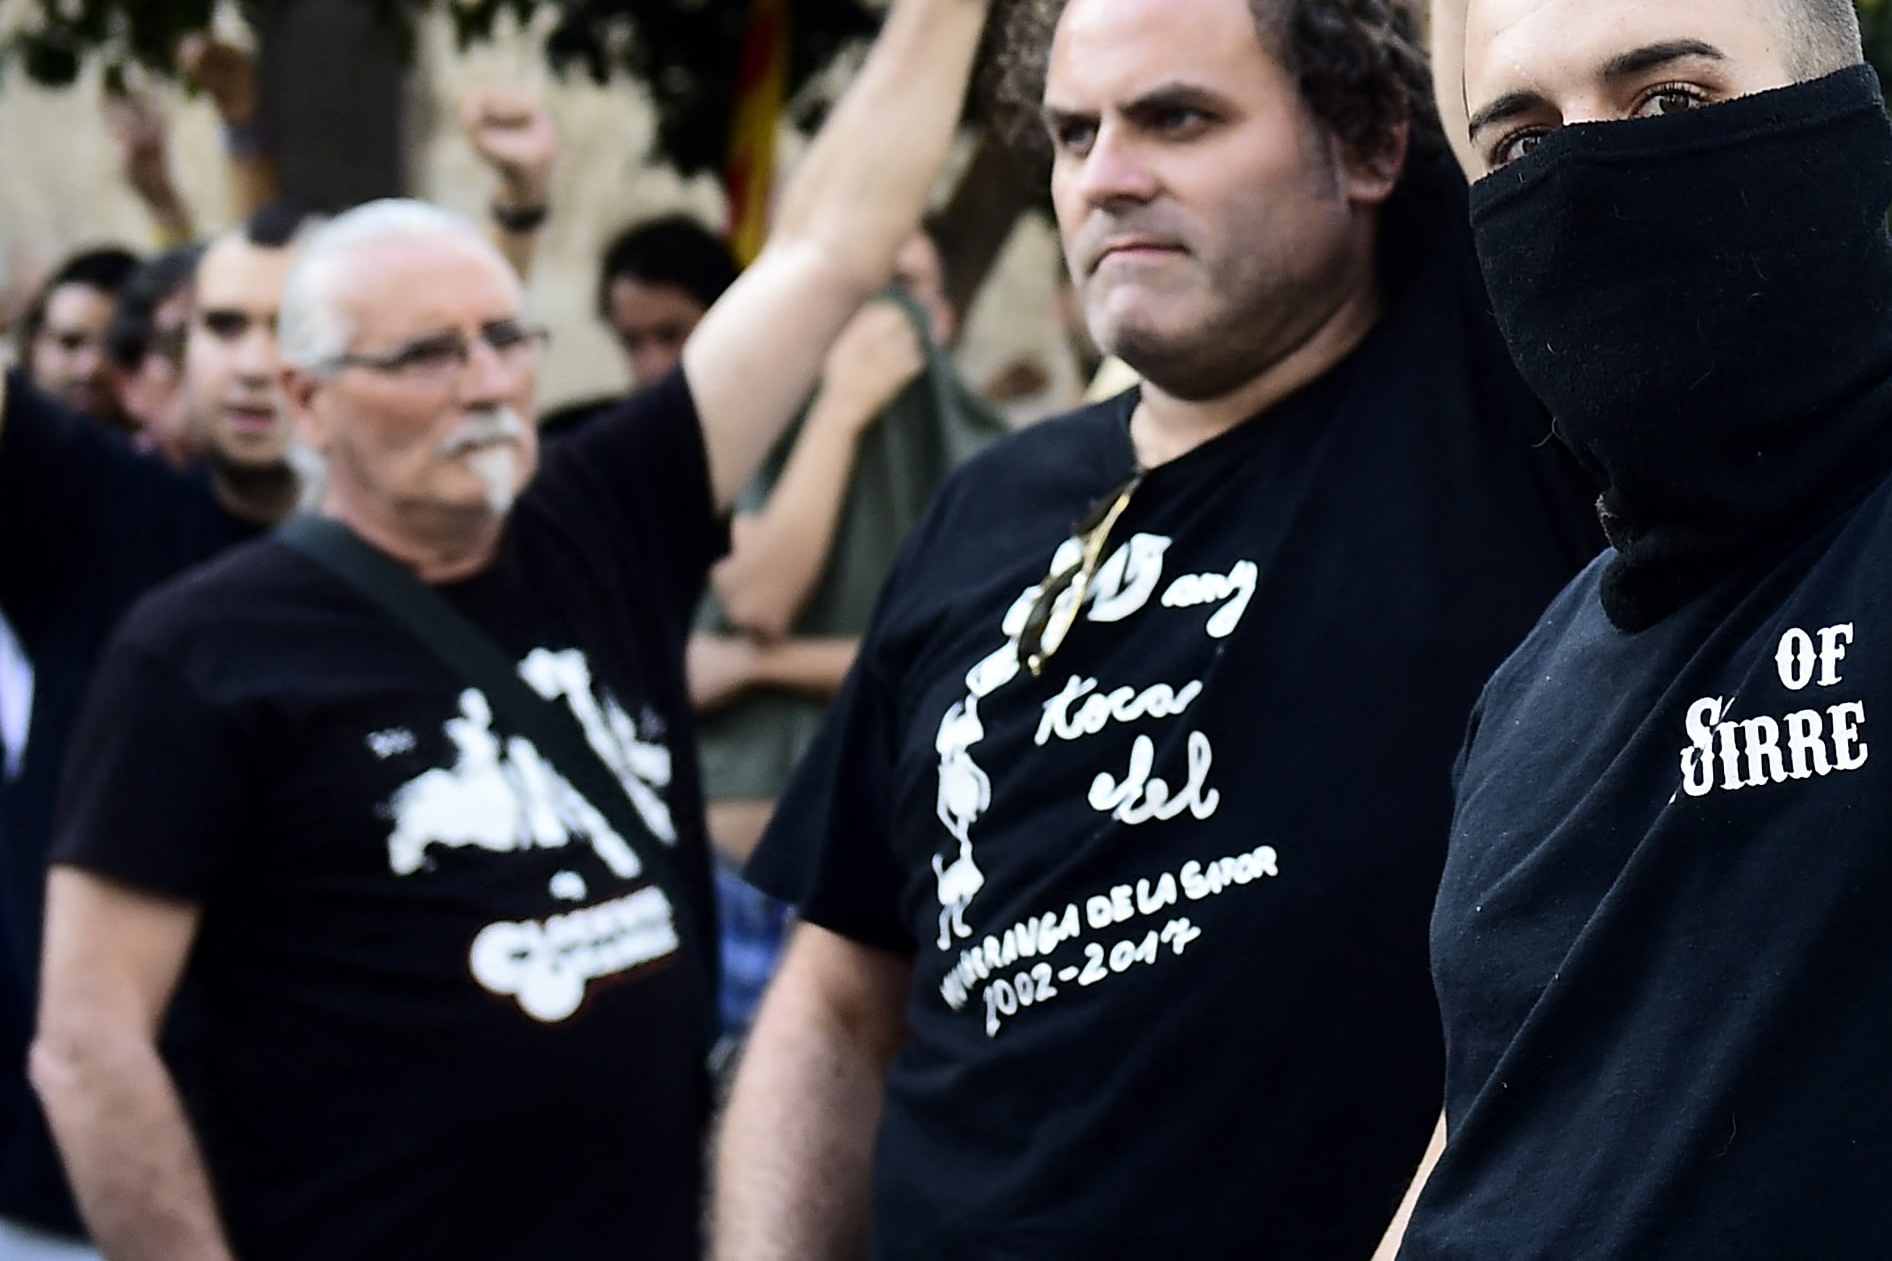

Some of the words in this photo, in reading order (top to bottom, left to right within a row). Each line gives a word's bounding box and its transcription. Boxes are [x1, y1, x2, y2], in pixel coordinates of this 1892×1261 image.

[1775, 622, 1854, 691] OF
[1086, 883, 1134, 928] DE
[1136, 873, 1178, 914] LA
